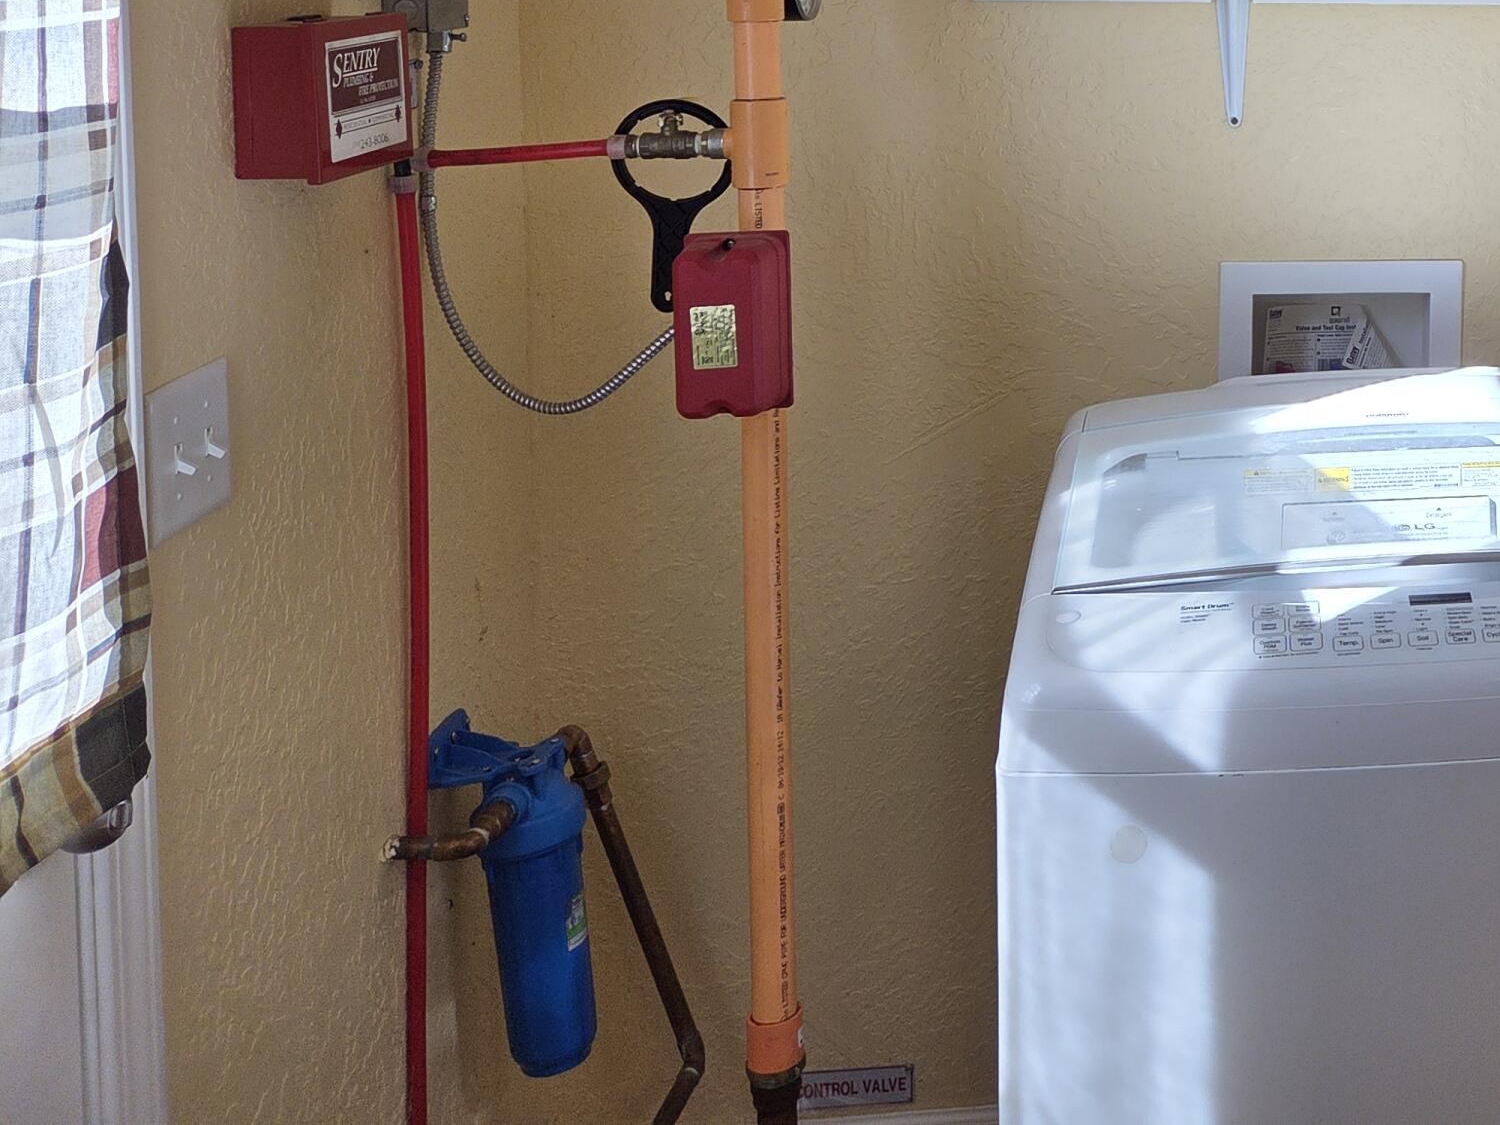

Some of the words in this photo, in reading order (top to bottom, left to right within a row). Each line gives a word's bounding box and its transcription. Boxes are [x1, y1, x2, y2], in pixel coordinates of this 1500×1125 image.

[332, 47, 381, 88] SENTRY
[343, 73, 370, 89] PLUMBING
[358, 83, 369, 97] FIRE
[370, 78, 399, 95] PROTECTION
[754, 202, 763, 229] LISTED
[774, 589, 782, 640] Installation
[1378, 637, 1393, 645] Spin
[779, 874, 787, 921] UNDERGROUND
[779, 925, 787, 939] FOR
[779, 941, 788, 959] PIPE
[862, 1076, 908, 1094] VALVE
